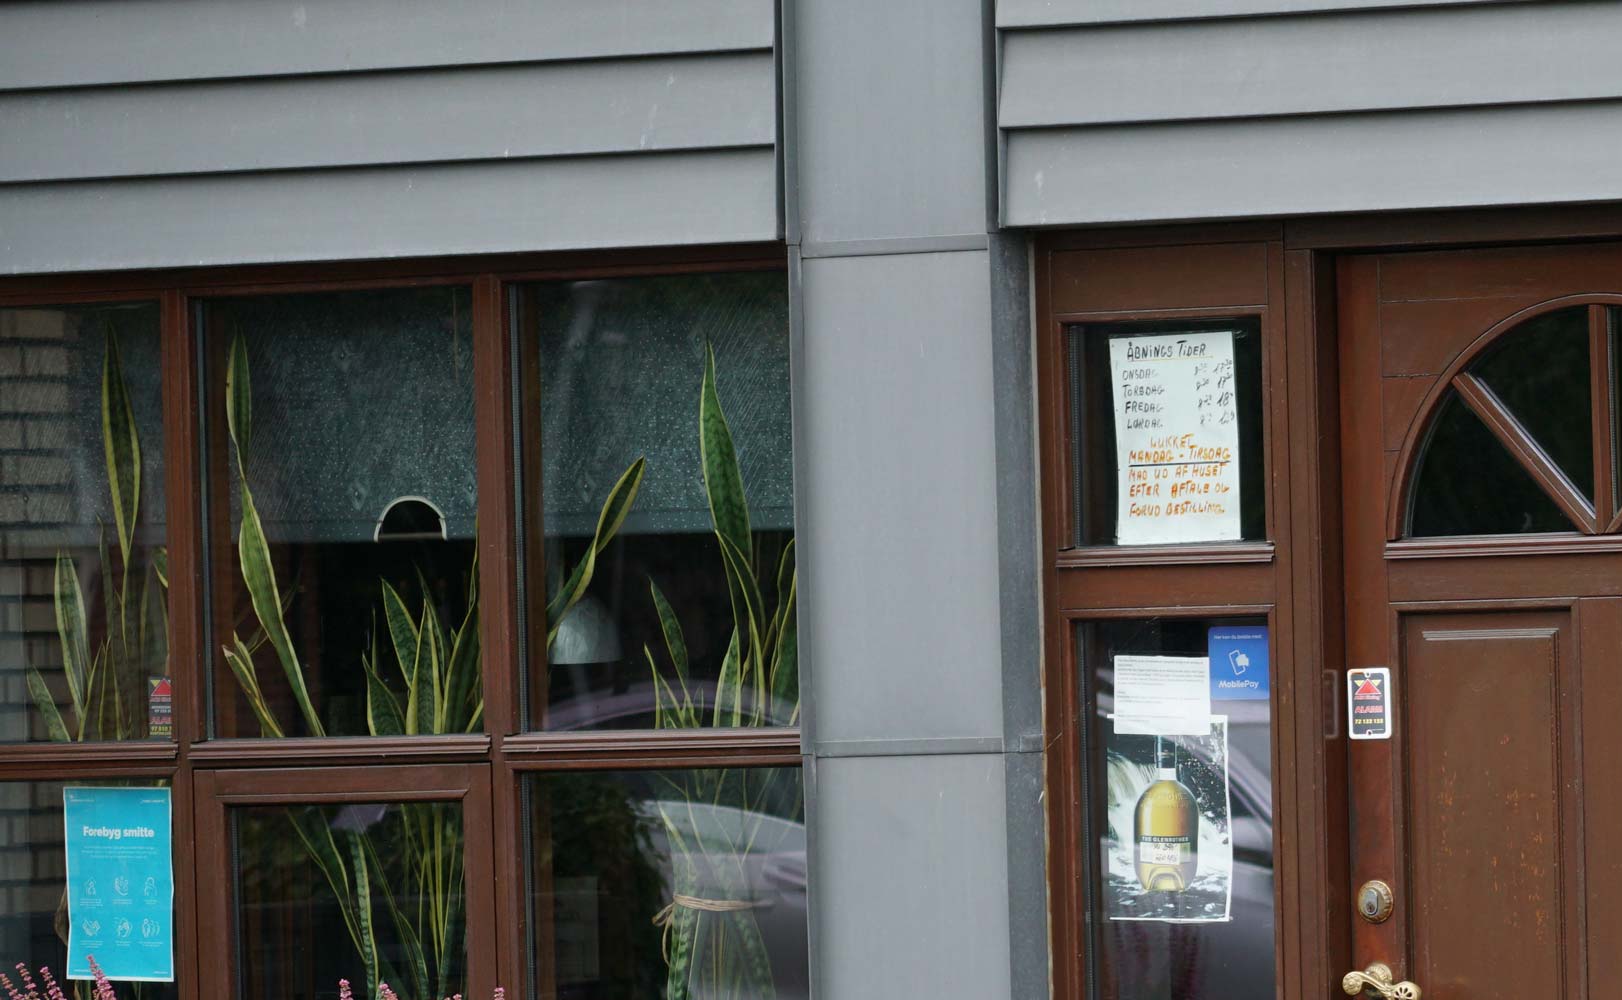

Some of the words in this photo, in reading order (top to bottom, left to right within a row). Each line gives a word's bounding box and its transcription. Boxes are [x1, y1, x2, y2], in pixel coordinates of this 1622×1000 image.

[1122, 384, 1165, 398] TORSDAG
[1124, 401, 1164, 414] FREDAG
[1150, 433, 1195, 449] LUKKET
[1128, 450, 1174, 464] MANDAG
[1189, 445, 1231, 460] TIRSDAG
[1128, 468, 1148, 481] MAD
[1175, 464, 1188, 478] AF
[1192, 461, 1229, 477] HUSET
[1129, 483, 1159, 497] EFTER
[1171, 480, 1210, 498] AFTALE
[1129, 503, 1160, 517] FORUD
[1218, 679, 1260, 690] MobilePay
[1354, 705, 1384, 713] ALARM
[83, 826, 121, 840] Forebyg
[123, 826, 155, 837] smitte
